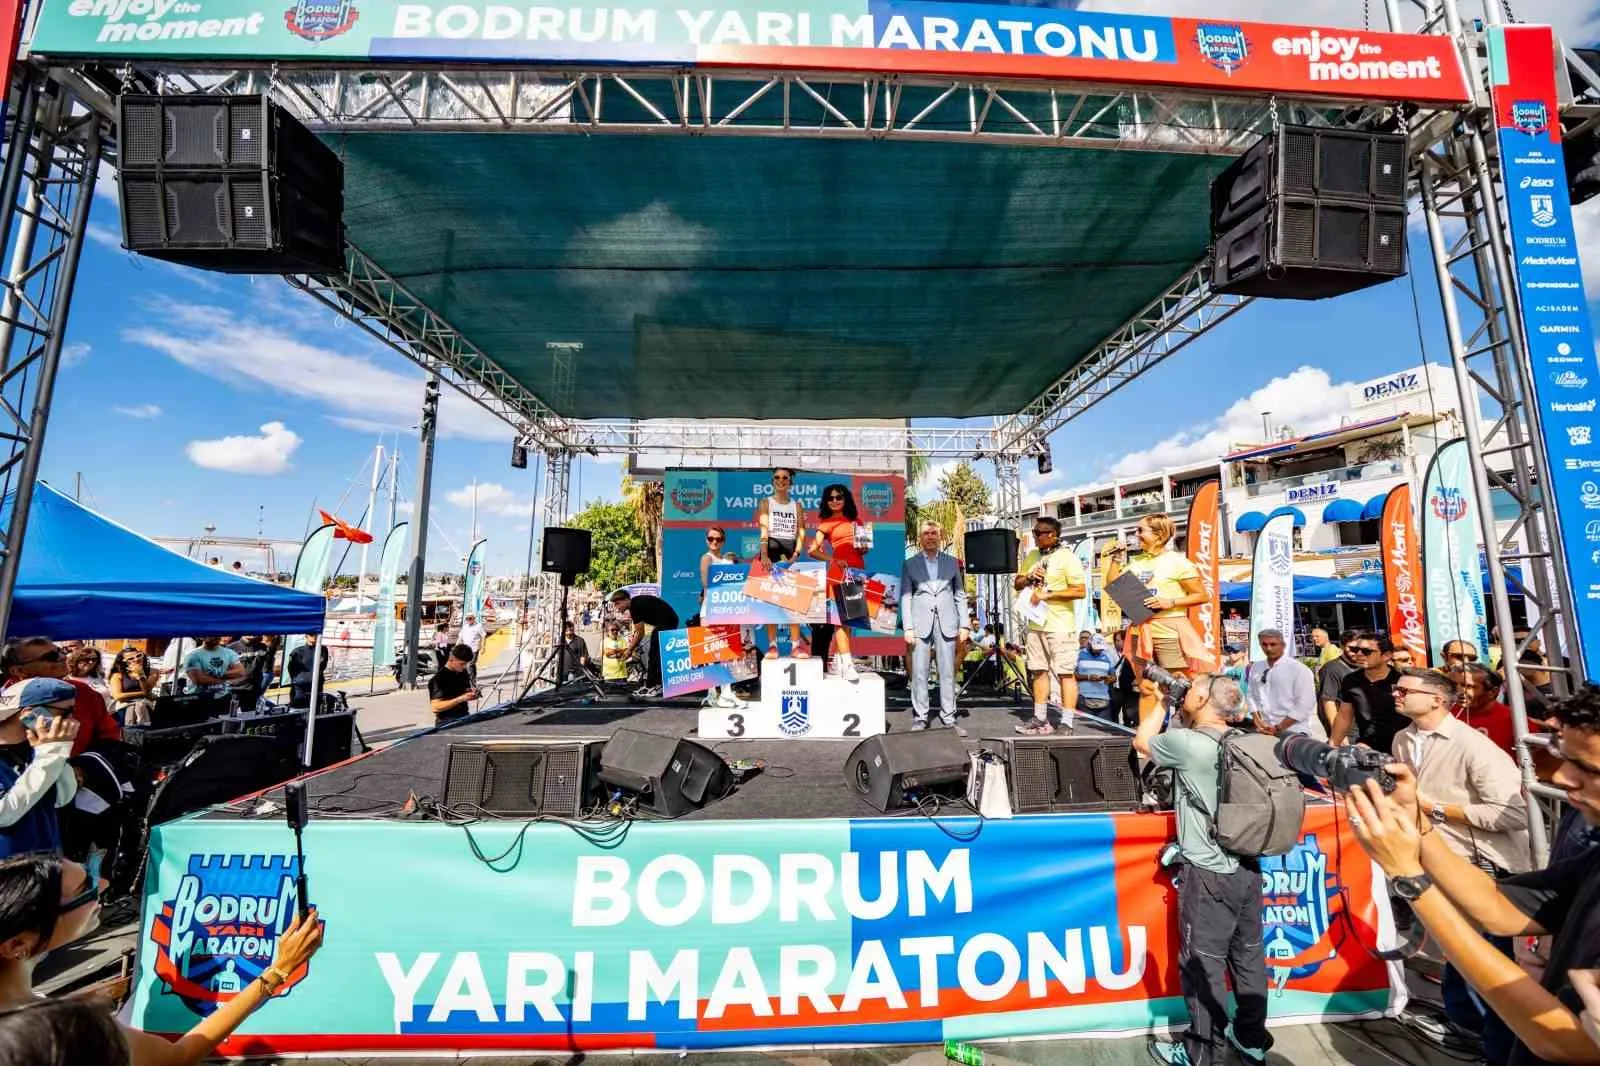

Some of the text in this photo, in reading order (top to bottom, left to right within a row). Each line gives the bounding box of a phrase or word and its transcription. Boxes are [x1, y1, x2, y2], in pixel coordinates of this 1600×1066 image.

[67, 0, 201, 22] enjoy the
[96, 12, 264, 43] moment
[392, 3, 1159, 63] BODRUM YARI MARATONU
[1272, 30, 1382, 61] enjoy the
[1309, 55, 1441, 81] moment
[1539, 325, 1581, 333] GARMIN
[752, 483, 817, 496] BORUM
[724, 496, 758, 509] YARI
[783, 662, 797, 686] 1
[727, 713, 745, 737] 3
[842, 713, 861, 737] 2
[572, 848, 973, 927] BODRUM
[172, 875, 300, 935] BODRUM
[1263, 905, 1311, 924] ATON
[206, 925, 264, 937] YARI
[376, 924, 1148, 1022] YARI MARATONU
